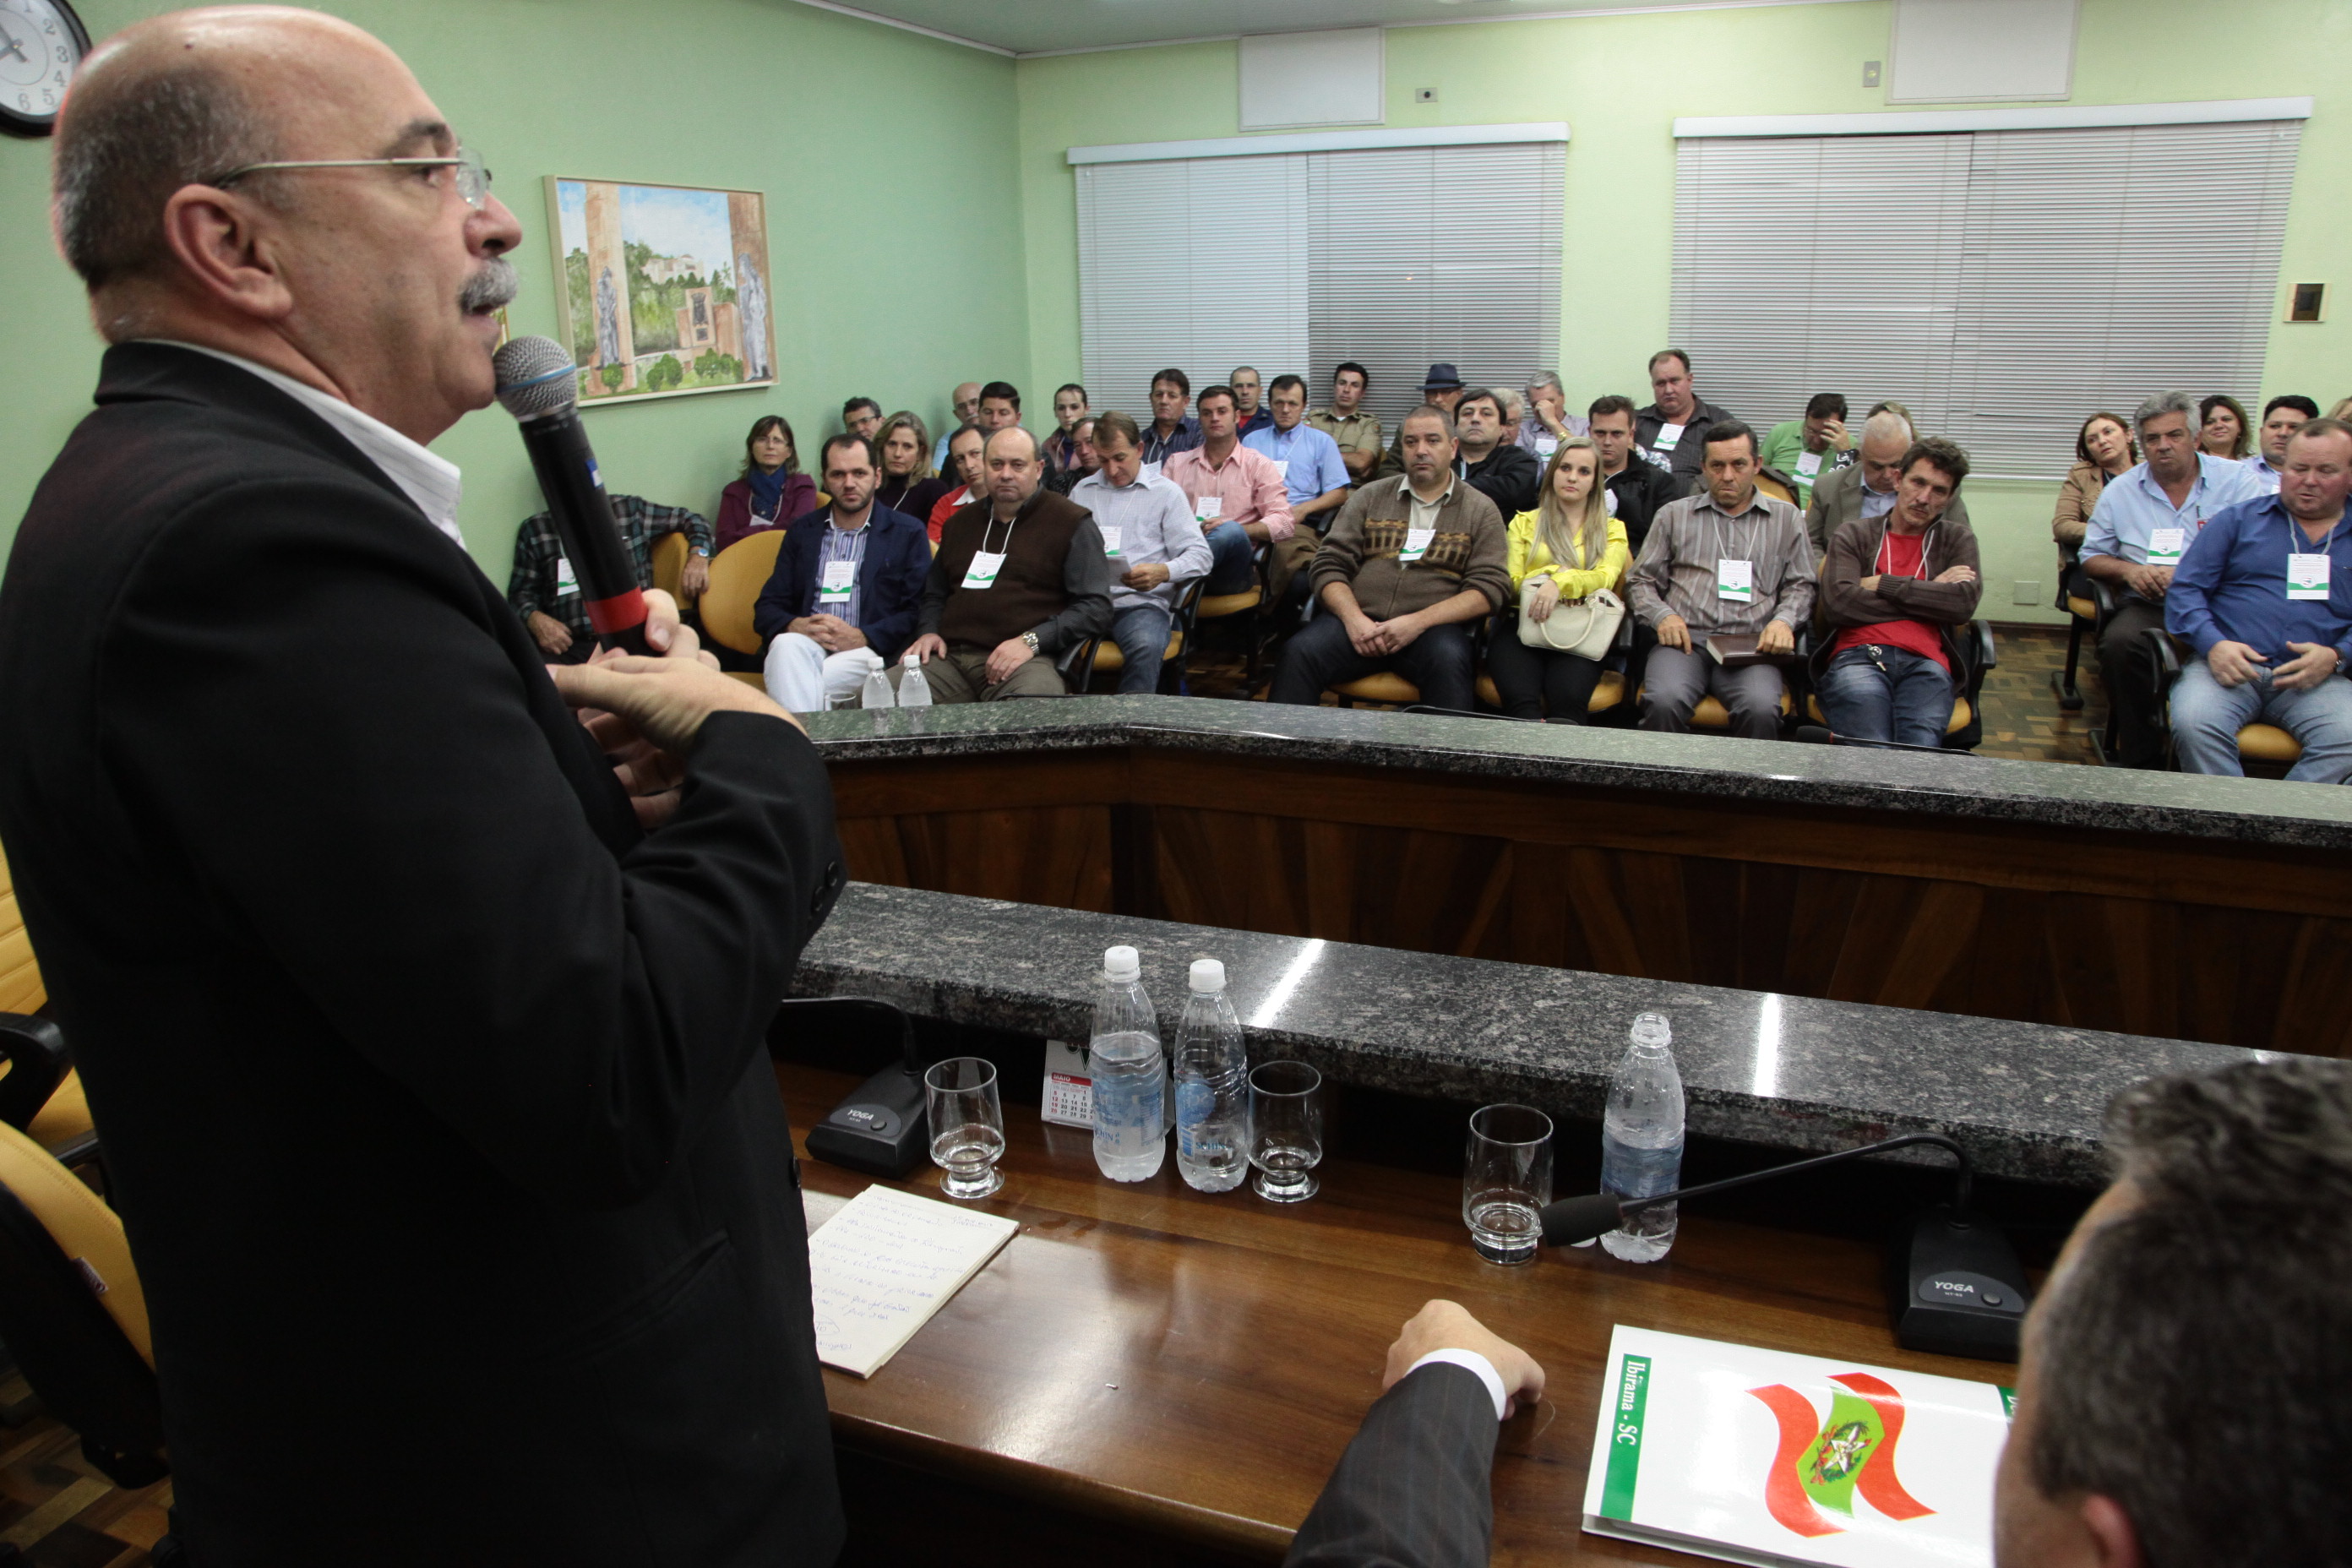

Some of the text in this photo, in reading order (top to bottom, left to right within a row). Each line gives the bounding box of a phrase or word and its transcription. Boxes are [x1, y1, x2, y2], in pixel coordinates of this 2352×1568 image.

[42, 19, 56, 35] 2
[56, 46, 69, 63] 3
[53, 70, 67, 88] 4
[17, 93, 31, 112] 6
[42, 89, 55, 106] 5
[1053, 1074, 1071, 1082] MAIO
[847, 1108, 874, 1121] YOGA
[1935, 1281, 1974, 1293] YOGA
[1621, 1359, 1647, 1411] Ibirama
[1616, 1423, 1638, 1446] SC
